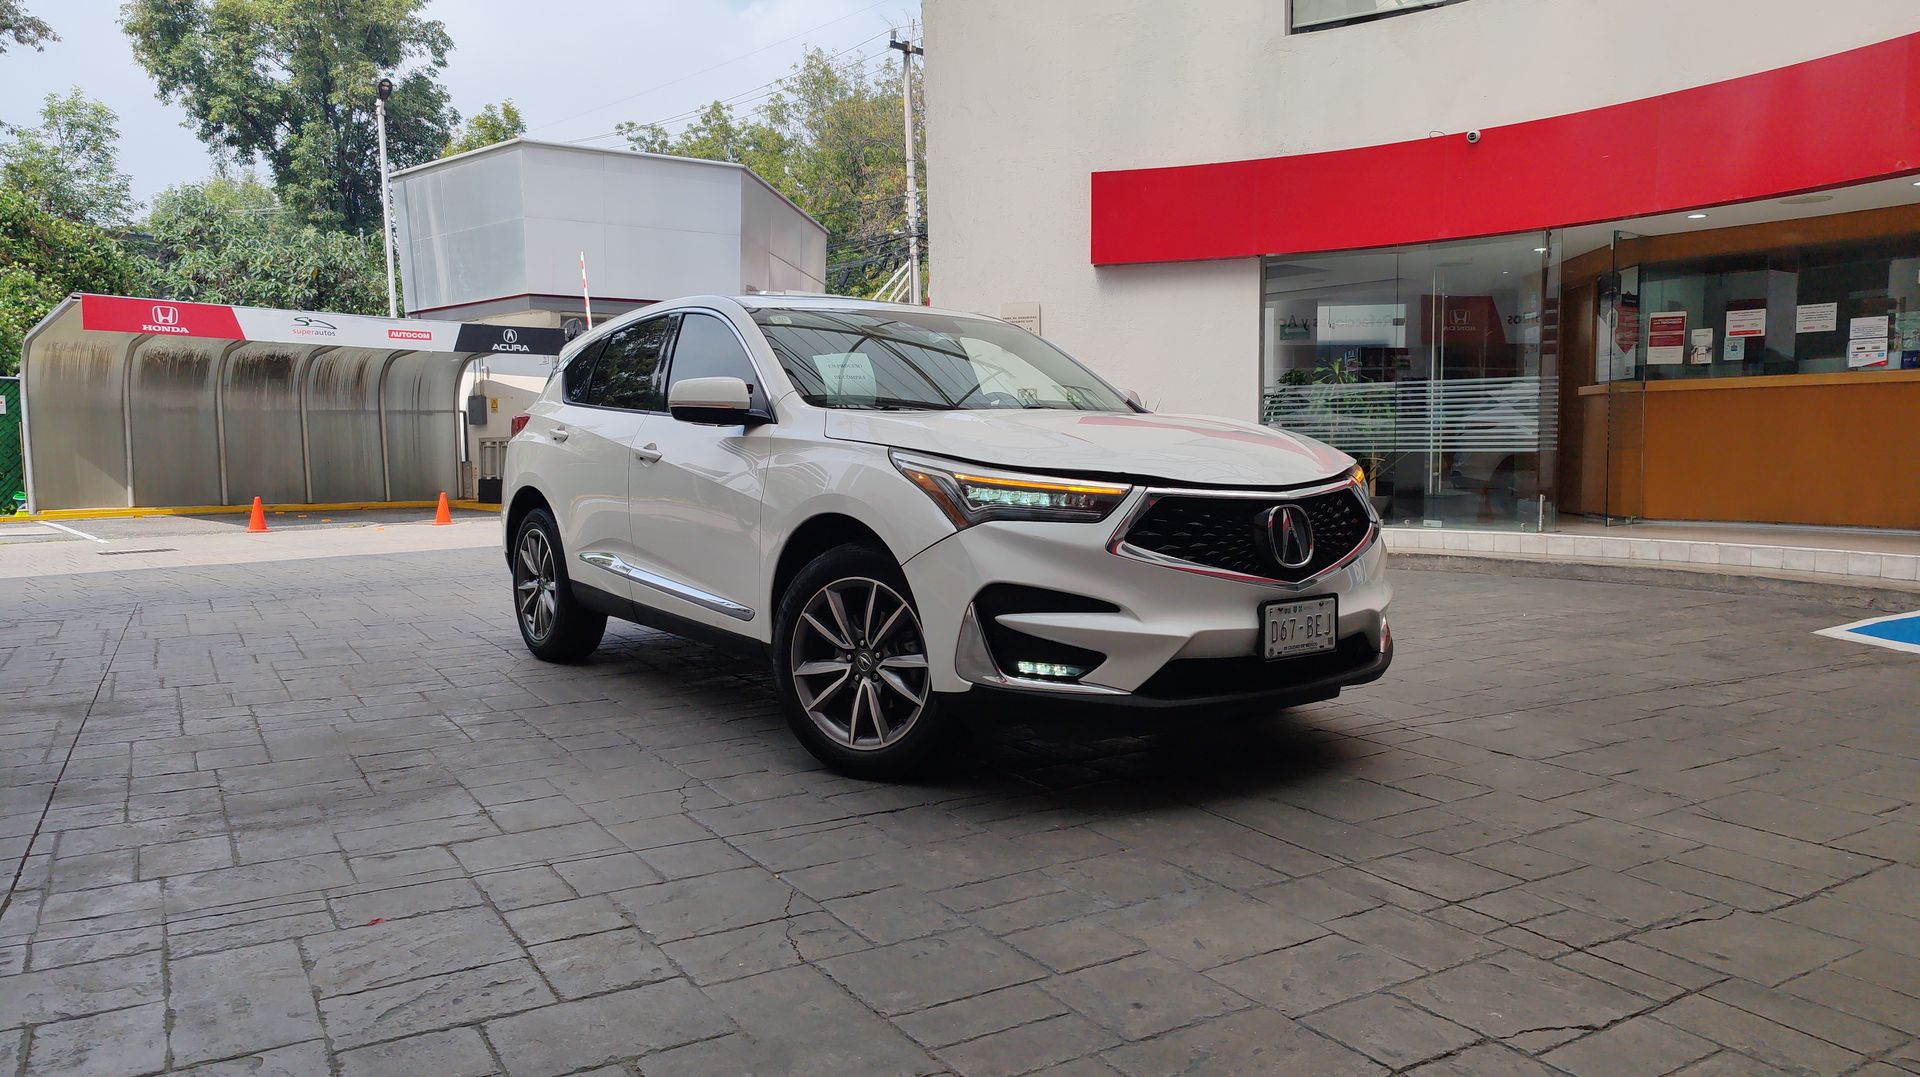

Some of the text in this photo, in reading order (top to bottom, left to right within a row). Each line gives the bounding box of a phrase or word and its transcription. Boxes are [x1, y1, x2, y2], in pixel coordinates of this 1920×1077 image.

[142, 324, 190, 334] HONDA
[292, 328, 336, 337] superautos
[390, 331, 431, 340] AUTOCOM
[491, 343, 530, 352] ACURA
[1271, 612, 1331, 643] D67-BEJ
